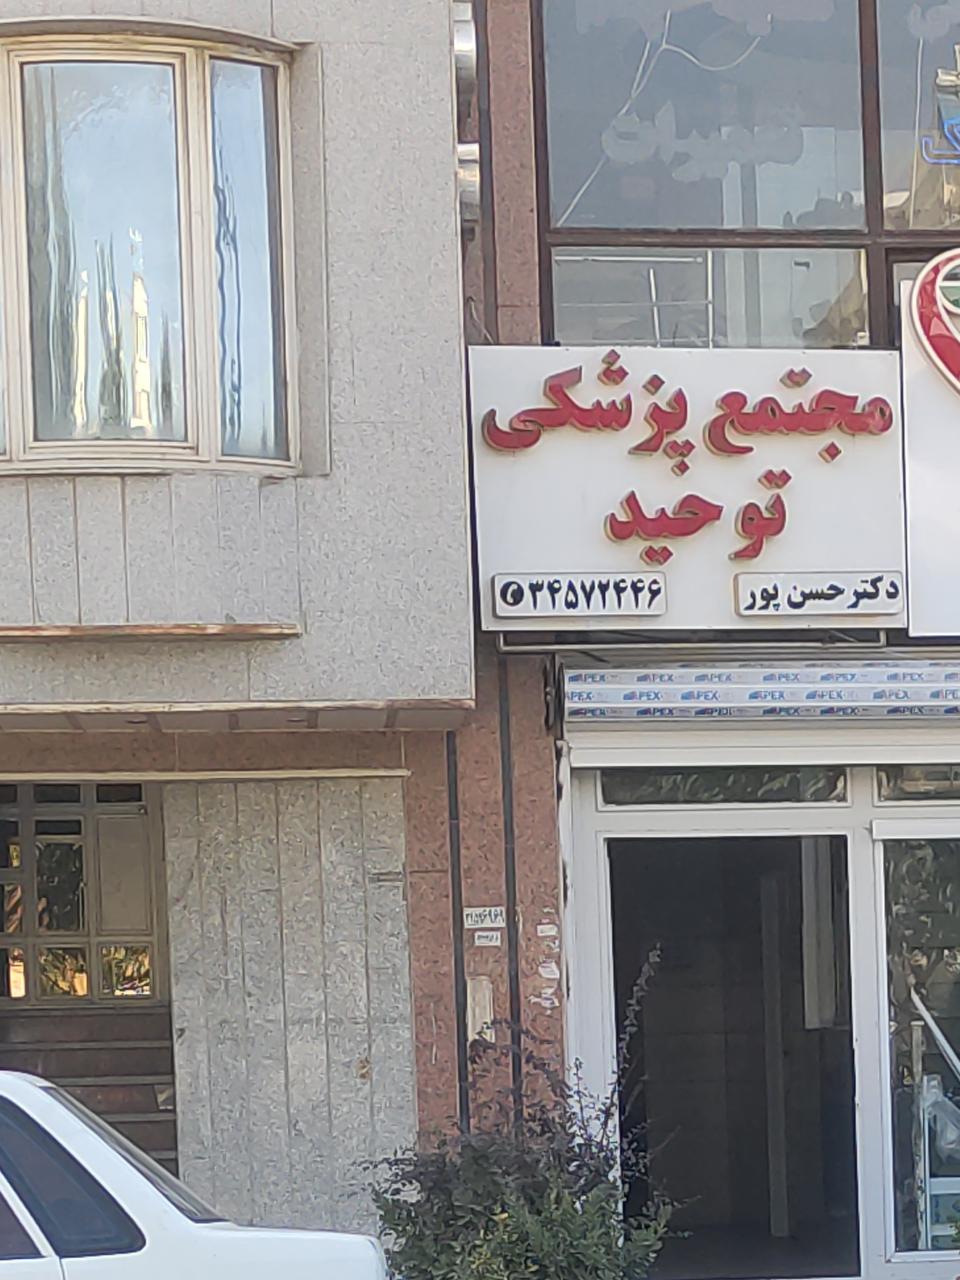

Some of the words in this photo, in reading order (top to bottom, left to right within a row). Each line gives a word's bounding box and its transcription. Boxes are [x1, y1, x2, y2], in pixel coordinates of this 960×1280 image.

[481, 349, 697, 477] پزشکی
[702, 366, 895, 463] مجتمع
[604, 467, 793, 566] توحید
[528, 578, 662, 610] ۳۴۵۷۲۴۴۶
[743, 583, 781, 612] پور
[786, 583, 846, 610] حسن
[847, 575, 900, 610] دکتر
